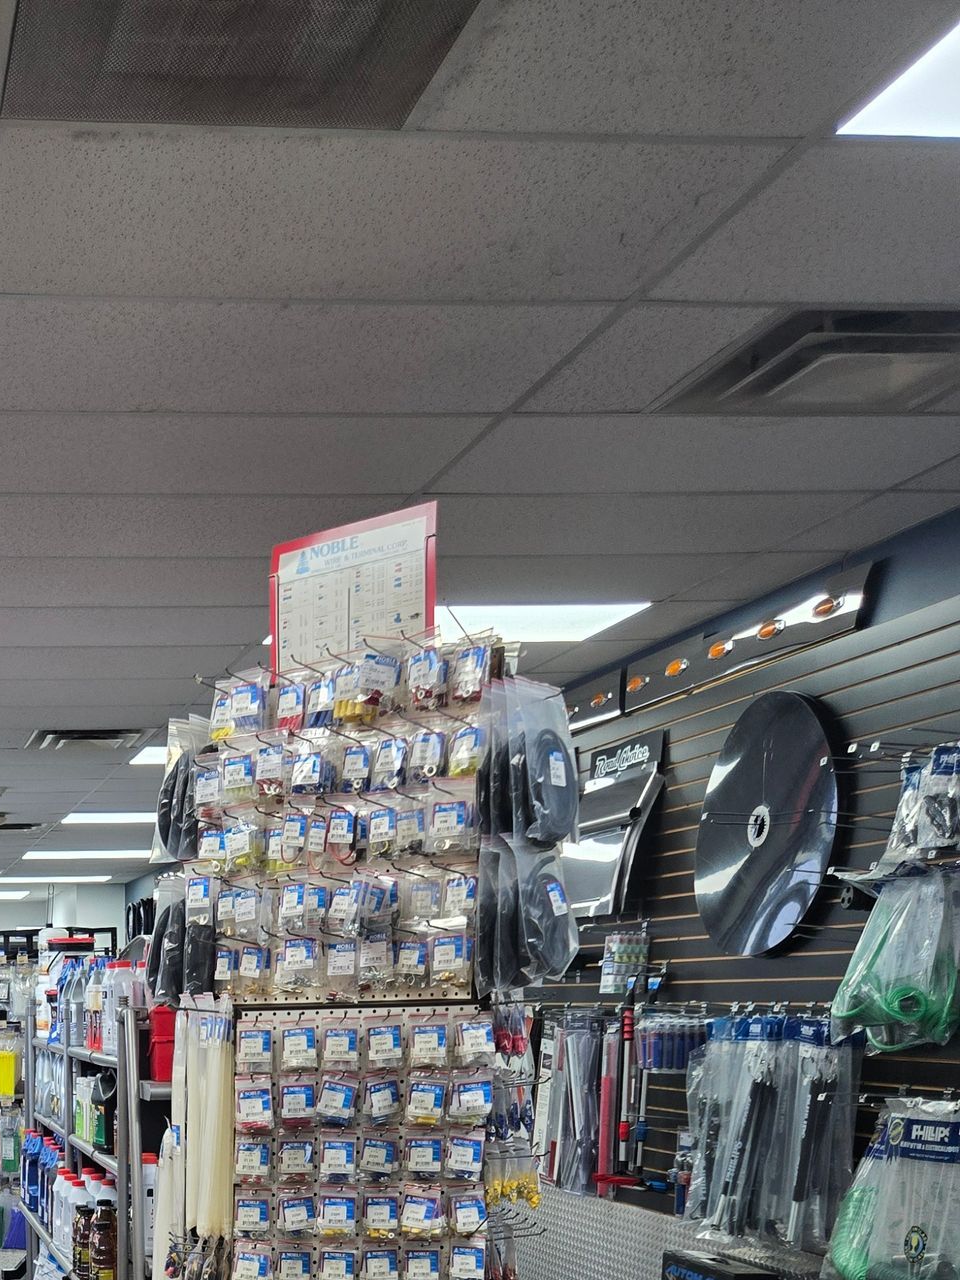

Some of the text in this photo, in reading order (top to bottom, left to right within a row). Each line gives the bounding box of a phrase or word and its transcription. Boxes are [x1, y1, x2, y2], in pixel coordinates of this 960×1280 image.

[309, 536, 359, 559] NOBLE
[323, 556, 342, 567] WIRE
[351, 545, 385, 561] TERMINAL
[618, 744, 650, 770] Choice
